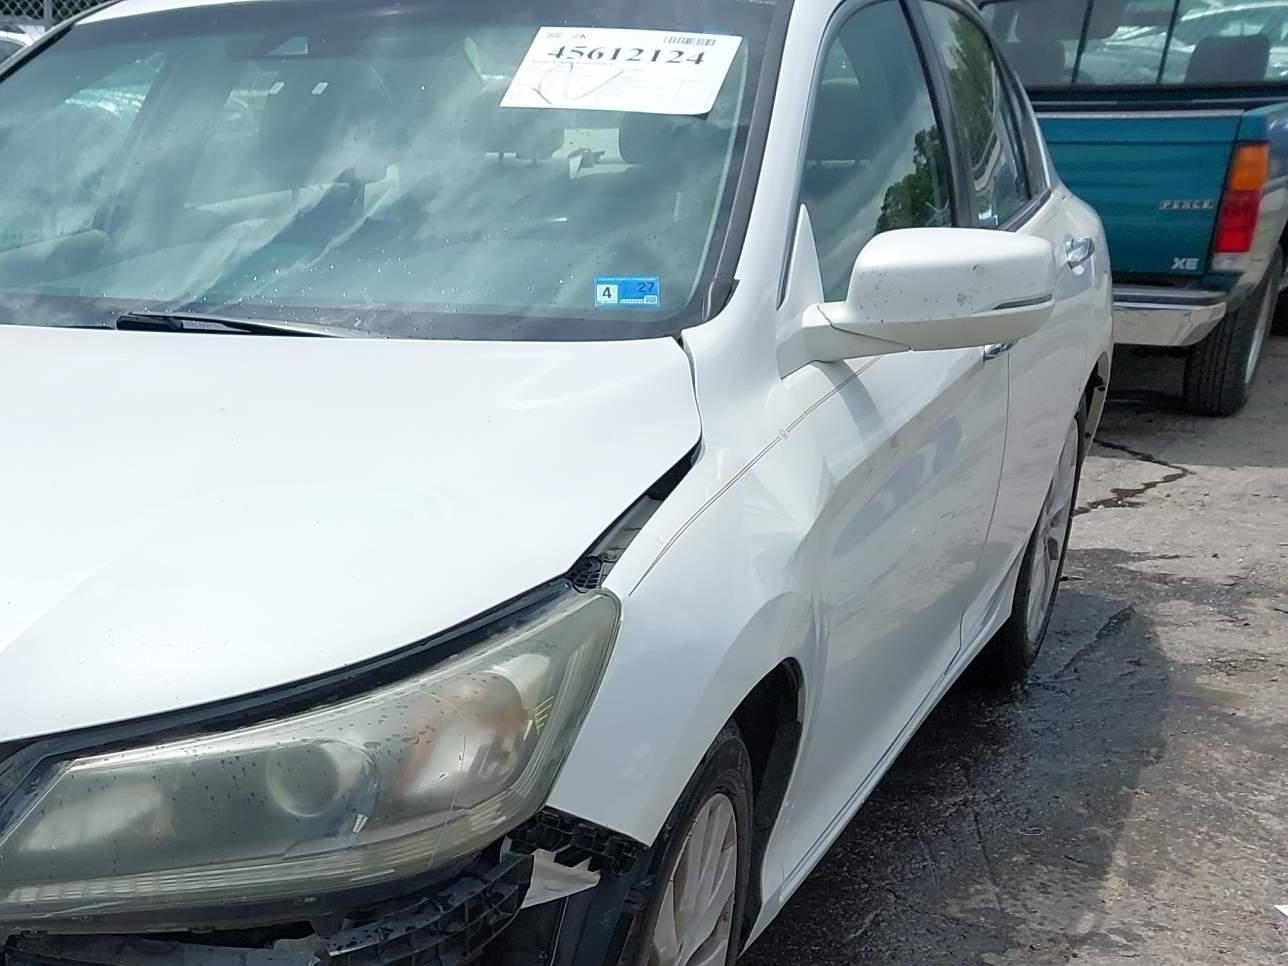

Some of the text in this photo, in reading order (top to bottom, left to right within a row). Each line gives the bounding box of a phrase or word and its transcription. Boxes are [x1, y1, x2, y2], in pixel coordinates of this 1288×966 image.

[547, 45, 706, 65] 45612124
[1170, 257, 1200, 271] XE
[601, 286, 613, 299] 4
[637, 281, 655, 293] 27
